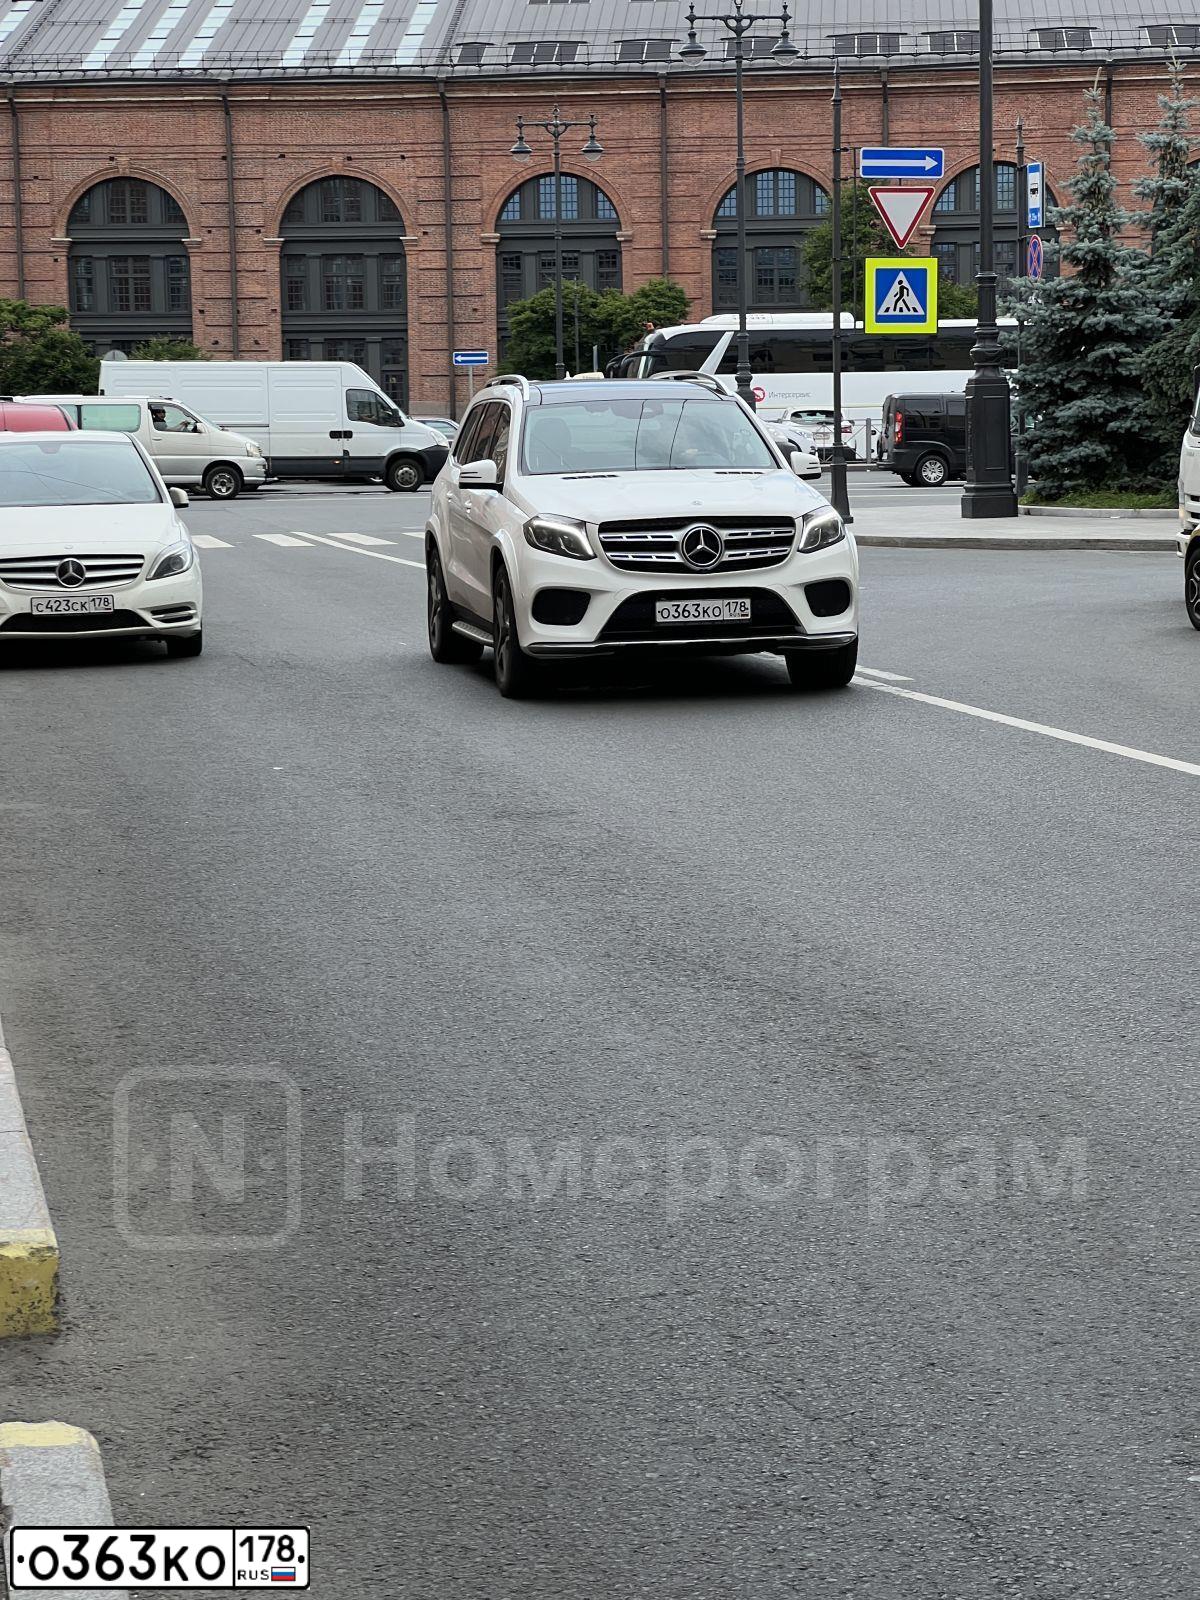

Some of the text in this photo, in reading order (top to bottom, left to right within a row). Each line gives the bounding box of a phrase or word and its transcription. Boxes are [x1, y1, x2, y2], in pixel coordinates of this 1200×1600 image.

[90, 597, 110, 607] 178
[660, 601, 746, 618] О363КО 178
